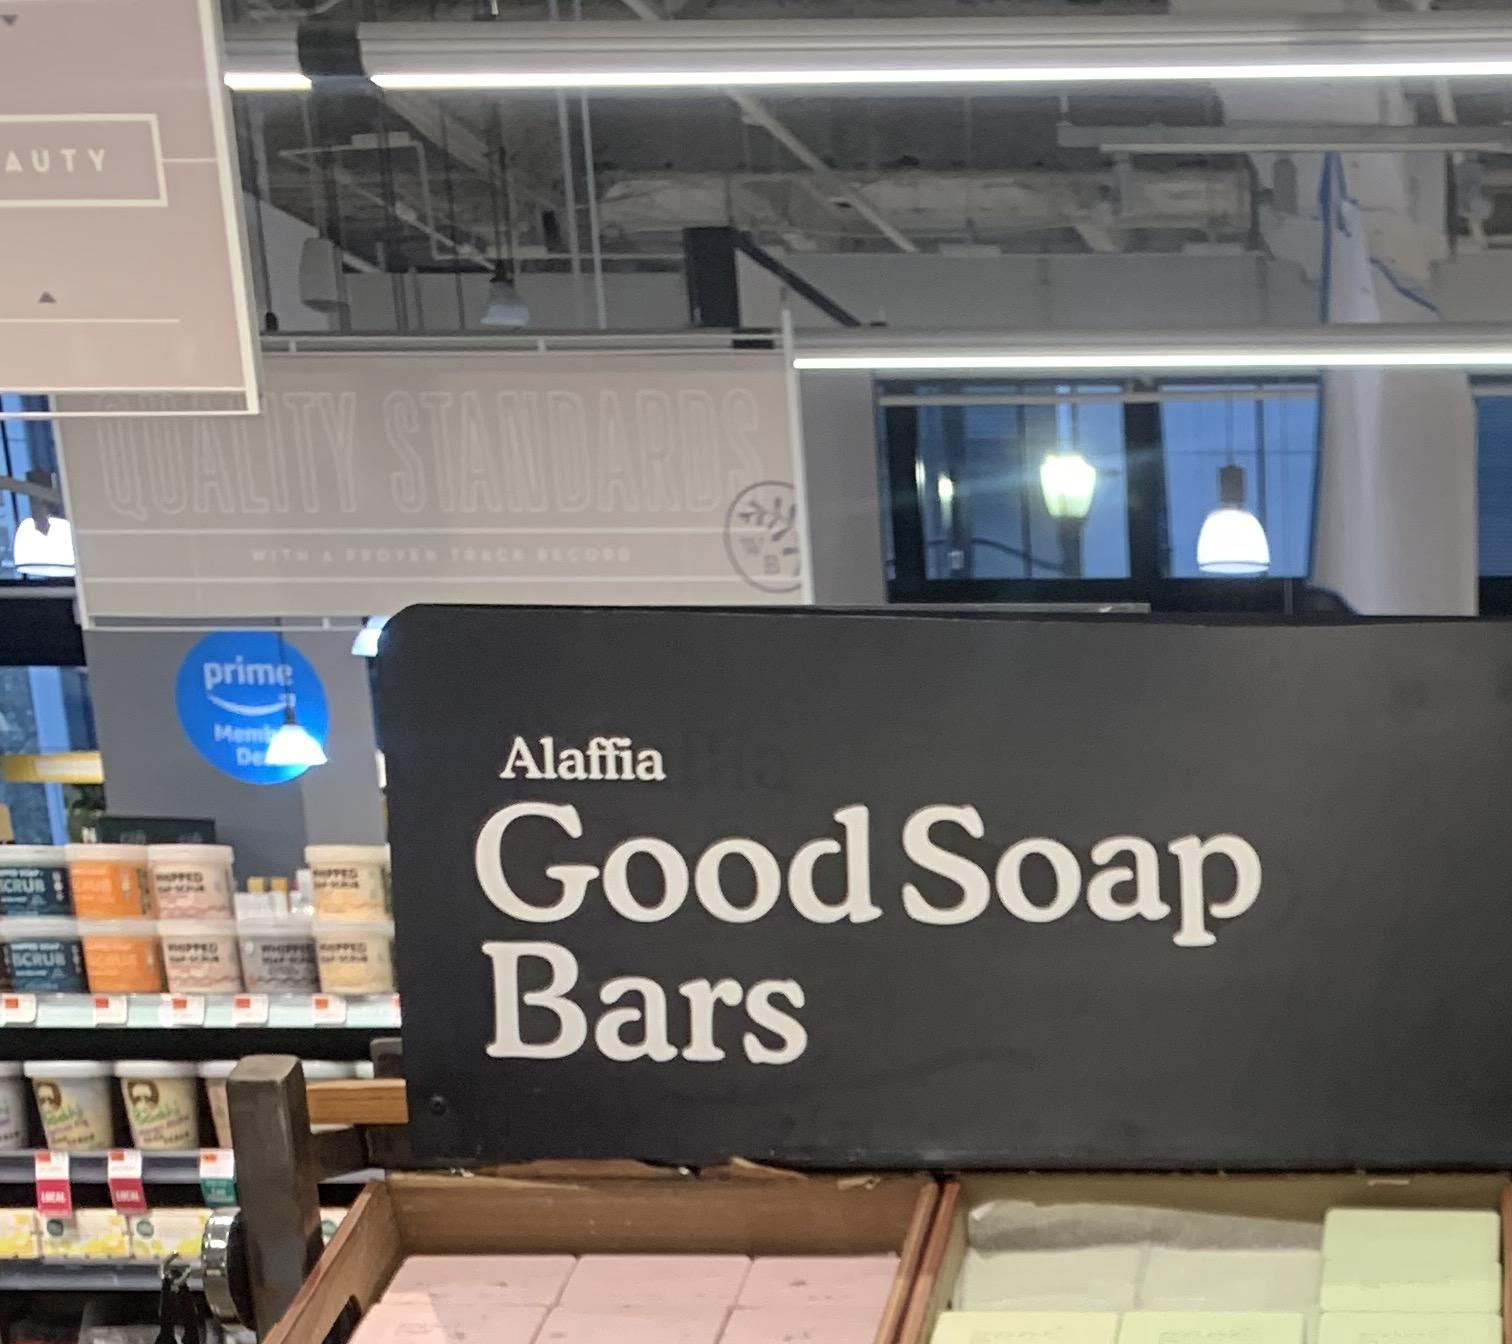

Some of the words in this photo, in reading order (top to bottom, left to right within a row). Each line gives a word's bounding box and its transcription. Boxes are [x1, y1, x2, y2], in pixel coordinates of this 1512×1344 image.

[101, 391, 358, 522] QUALITY
[382, 388, 770, 513] STANDARDS
[203, 655, 294, 691] prime
[499, 735, 667, 782] Alaffia
[474, 801, 883, 925] Good
[901, 802, 1263, 947] Soap
[480, 940, 809, 1065] Bars
